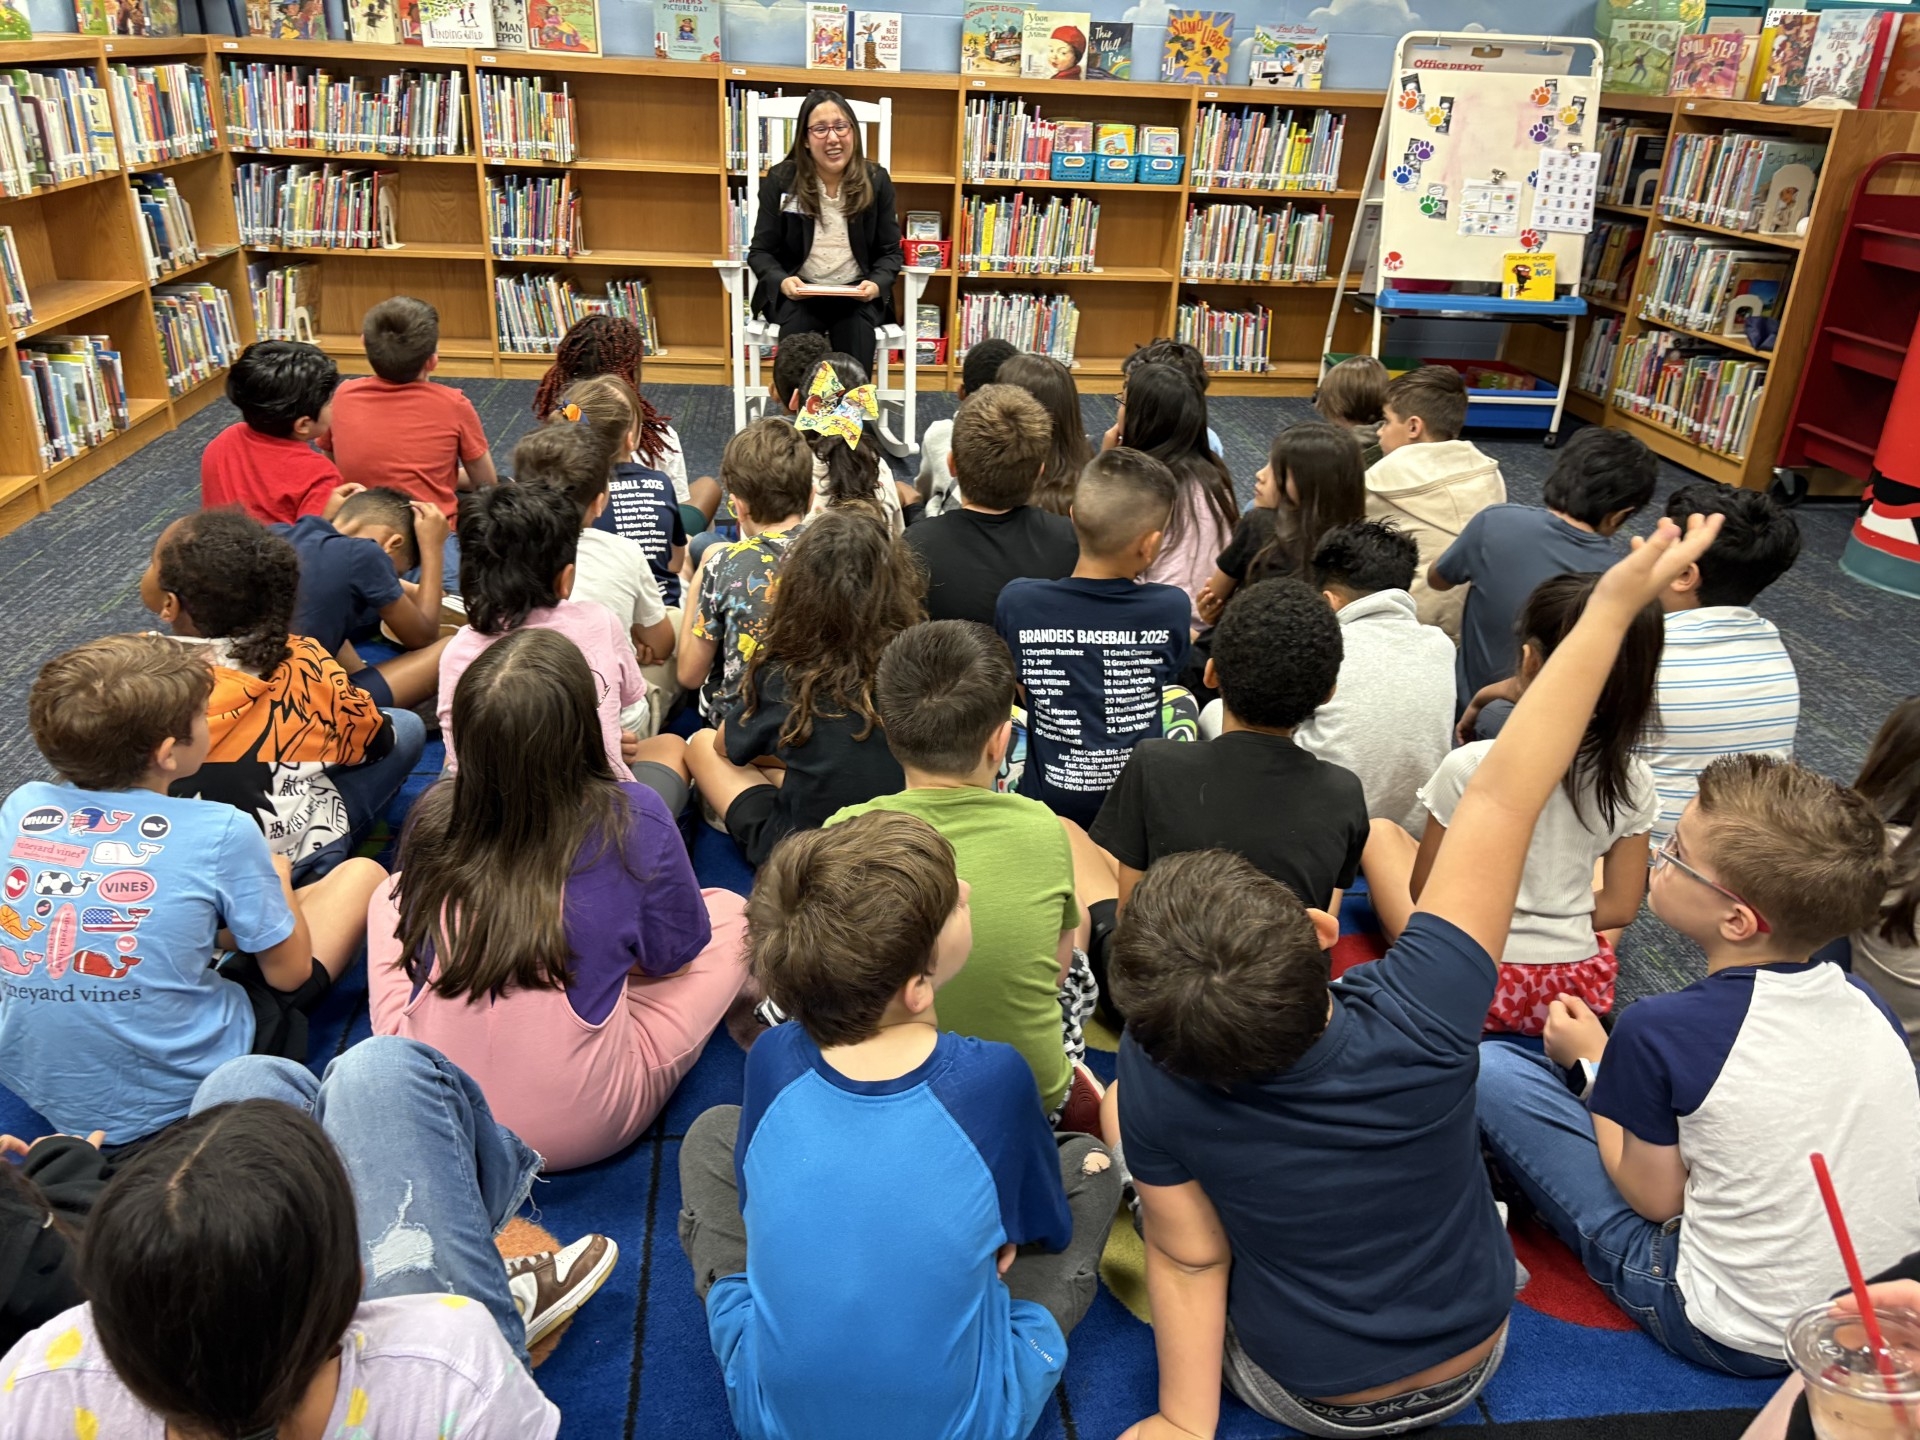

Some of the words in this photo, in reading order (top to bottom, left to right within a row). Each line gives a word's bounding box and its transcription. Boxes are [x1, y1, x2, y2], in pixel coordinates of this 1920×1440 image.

[1028, 13, 1048, 23] Yoon
[499, 20, 523, 32] MAN
[1172, 18, 1203, 36] SUMO
[1095, 25, 1113, 40] This
[1200, 25, 1229, 51] LIBRE
[1101, 37, 1122, 52] Will
[1414, 59, 1448, 70] Office
[1450, 63, 1484, 71] DEPOT
[640, 479, 664, 490] 2025
[1019, 629, 1074, 644] BRANDEIS
[1077, 630, 1138, 644] BASEBALL
[1140, 630, 1170, 644] 2025
[1056, 648, 1084, 656] Ramirez
[1042, 678, 1070, 686] Williams
[1047, 688, 1064, 696] Tello
[1051, 708, 1078, 716] Moreno
[1106, 716, 1116, 724] 23
[1116, 715, 1136, 723] Carlos
[1106, 726, 1116, 734] 24
[1106, 748, 1118, 756] Eric
[1064, 783, 1082, 791] Olivia
[24, 815, 62, 826] WHALE
[18, 841, 55, 854] vineyard
[105, 882, 149, 894] VINES
[80, 985, 142, 1002] vines
